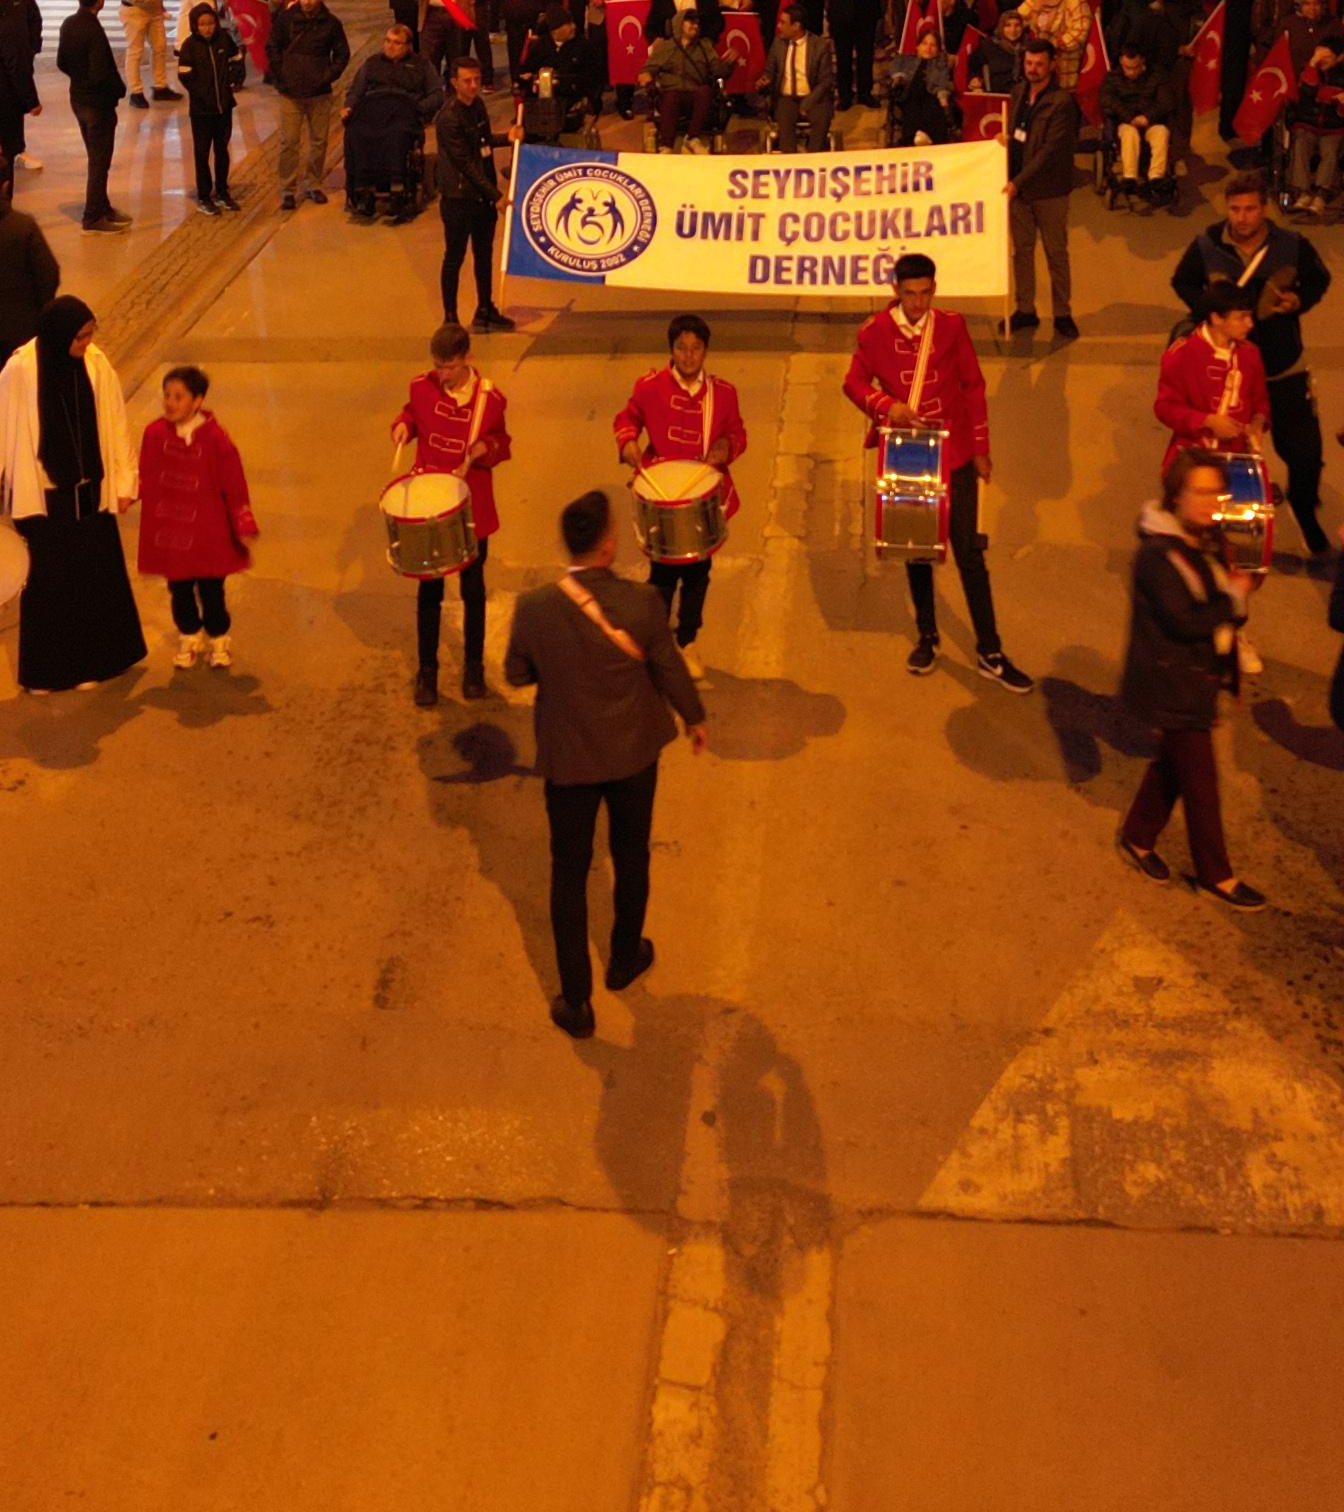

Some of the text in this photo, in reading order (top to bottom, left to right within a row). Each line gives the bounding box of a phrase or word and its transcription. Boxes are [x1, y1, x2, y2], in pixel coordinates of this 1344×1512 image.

[555, 167, 583, 183] ÜMİT
[726, 160, 935, 203] SEYDİŞEHİR
[673, 200, 985, 247] ÜMİT ÇOCUKLARI
[748, 245, 907, 286] DERNEĞ
